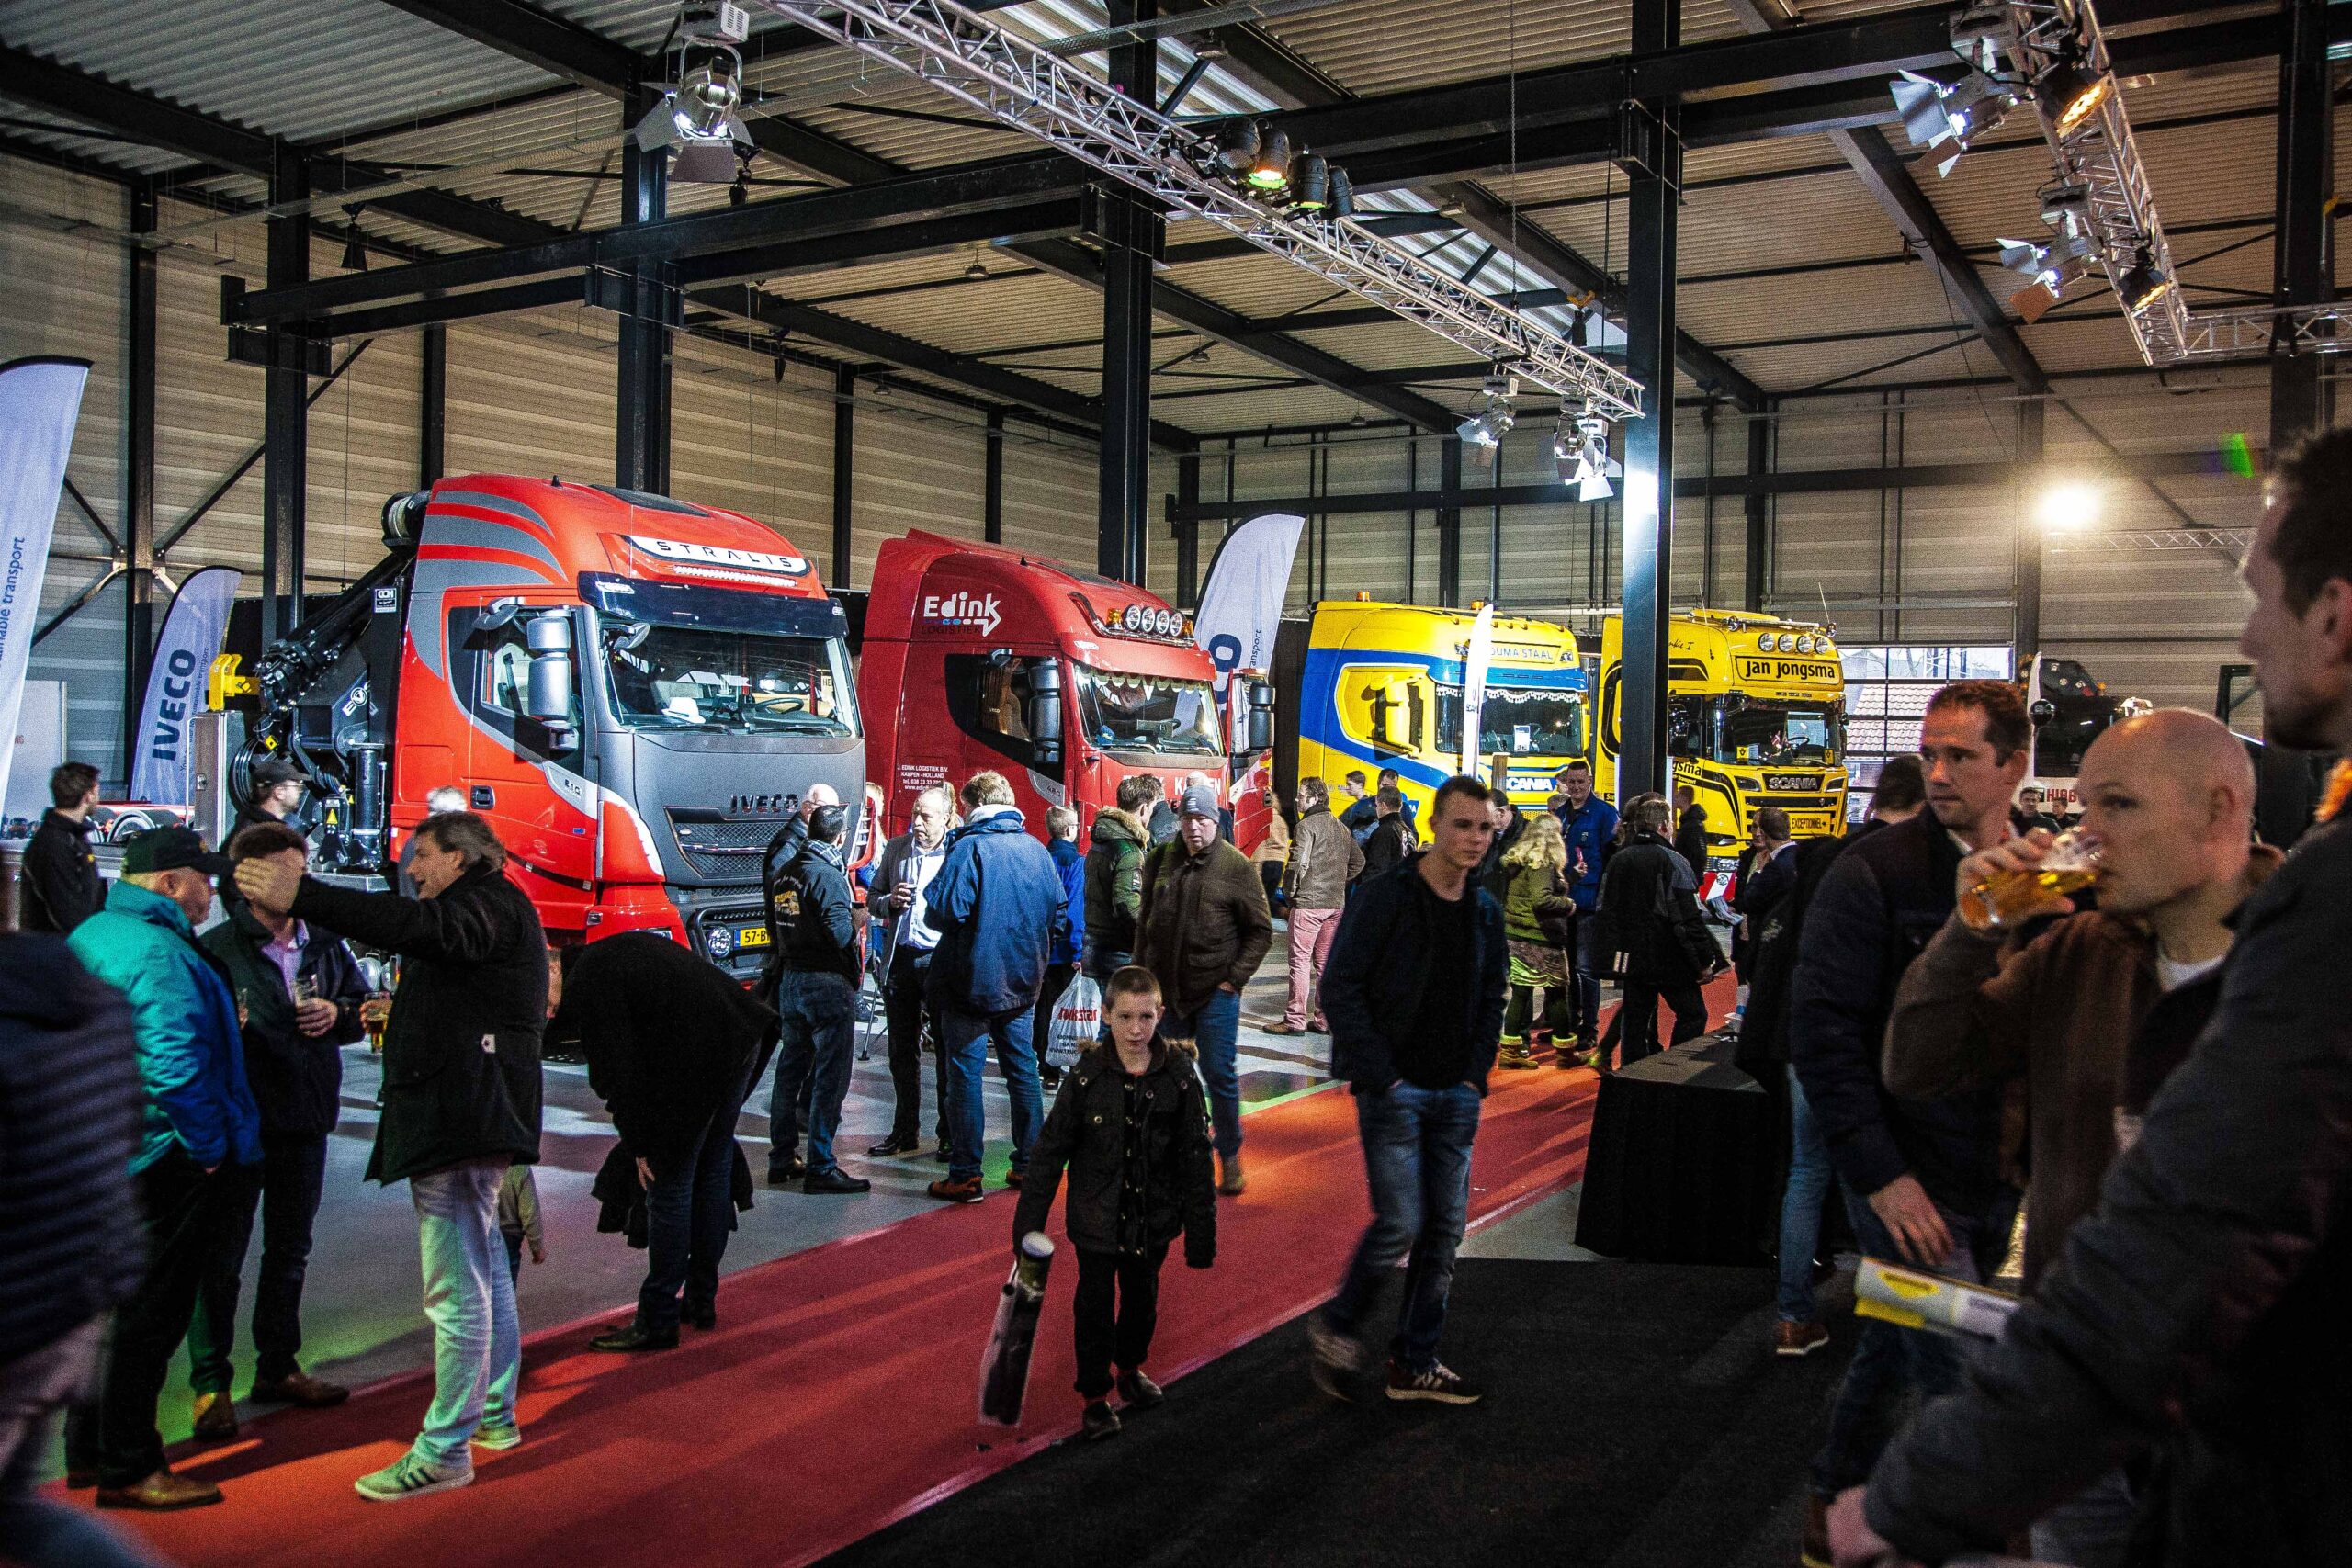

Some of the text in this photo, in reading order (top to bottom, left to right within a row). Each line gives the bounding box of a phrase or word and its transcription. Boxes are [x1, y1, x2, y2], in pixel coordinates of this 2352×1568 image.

[657, 541, 792, 568] STRALIS
[3, 536, 25, 604] transport
[923, 592, 1001, 621] Edink
[921, 626, 981, 635] LOGISTIEK
[1250, 629, 1261, 667] ansport
[1522, 649, 1553, 660] STAAL
[152, 649, 196, 761] IVECO
[1673, 761, 1702, 776] gsma
[1769, 777, 1818, 790] SCANIA
[730, 794, 798, 814] IVECO
[744, 930, 769, 944] 57-B
